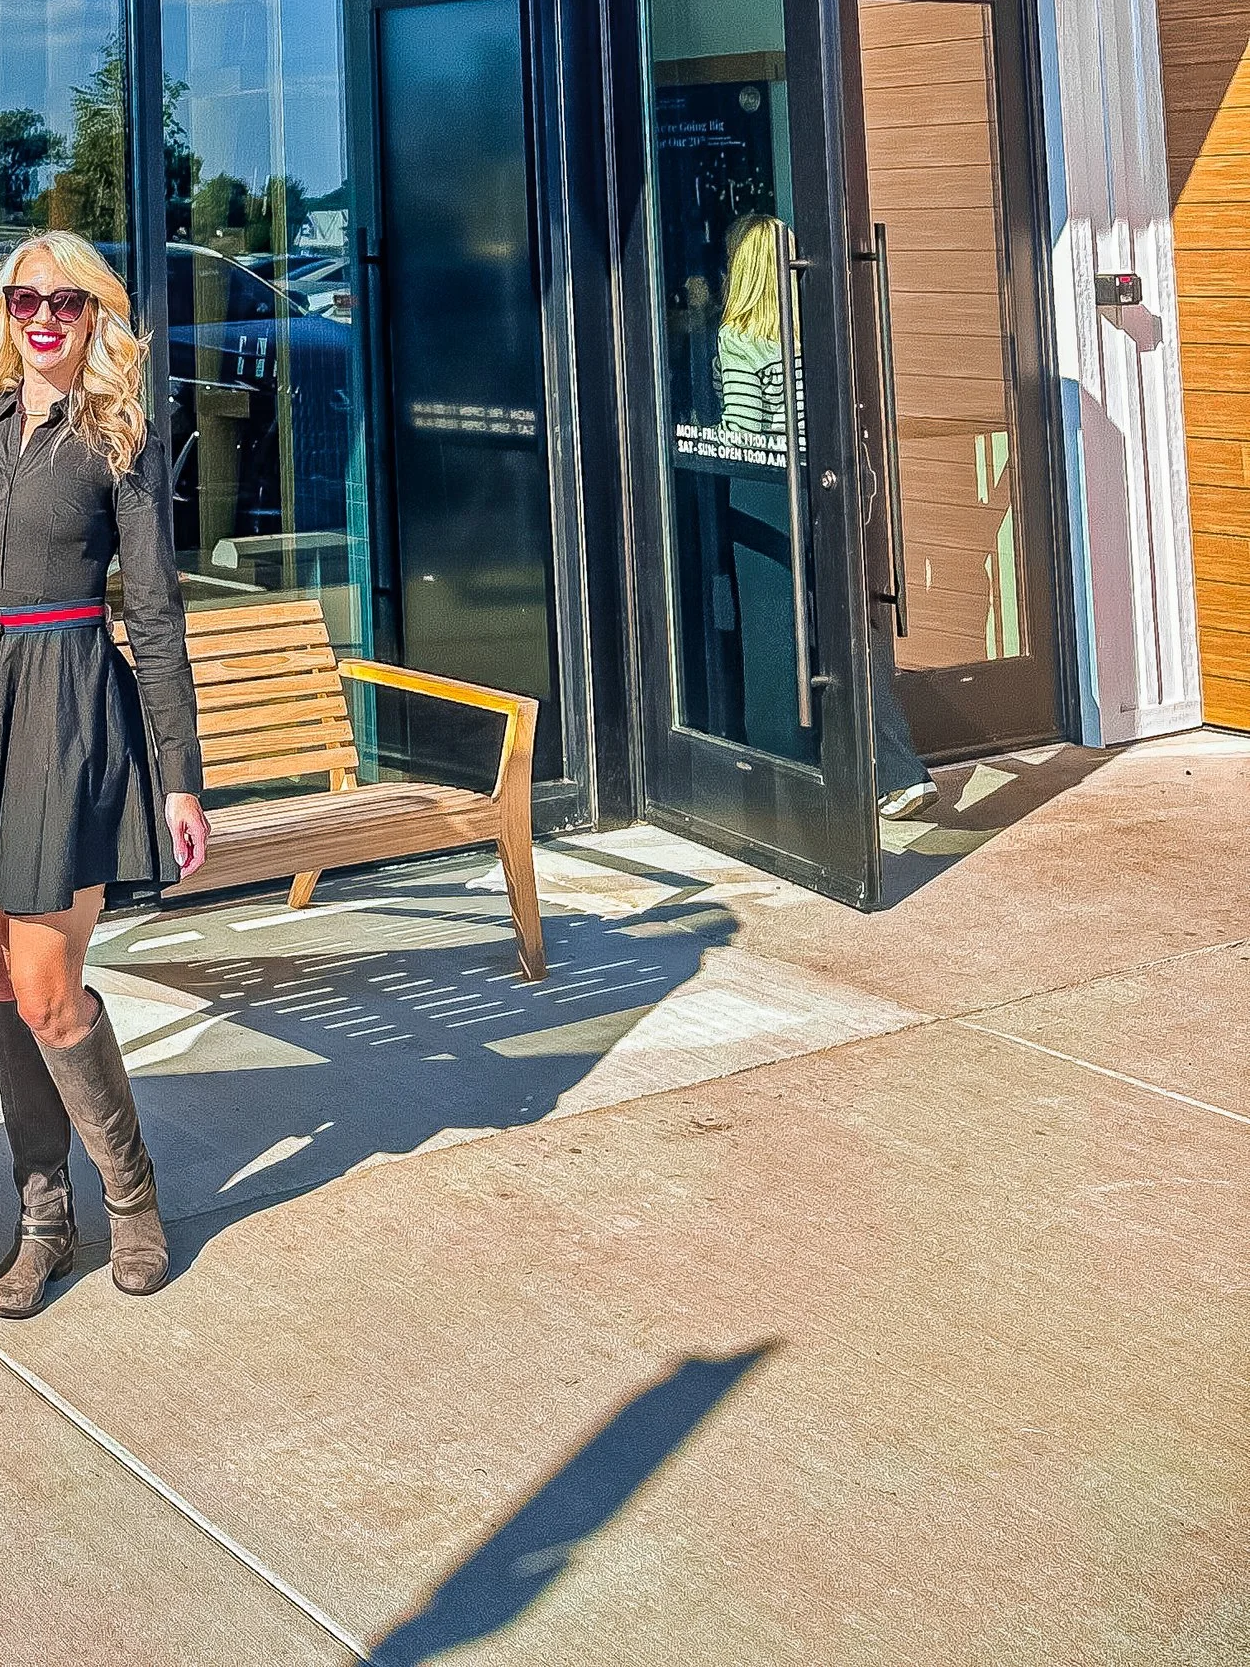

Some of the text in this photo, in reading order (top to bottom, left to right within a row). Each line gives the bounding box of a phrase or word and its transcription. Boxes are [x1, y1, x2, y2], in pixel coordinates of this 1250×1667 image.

[676, 423, 698, 439] MON
[718, 428, 742, 446] OPEN
[677, 439, 694, 454] SAT
[717, 445, 743, 462] OPEN
[743, 448, 767, 466] 10:00
